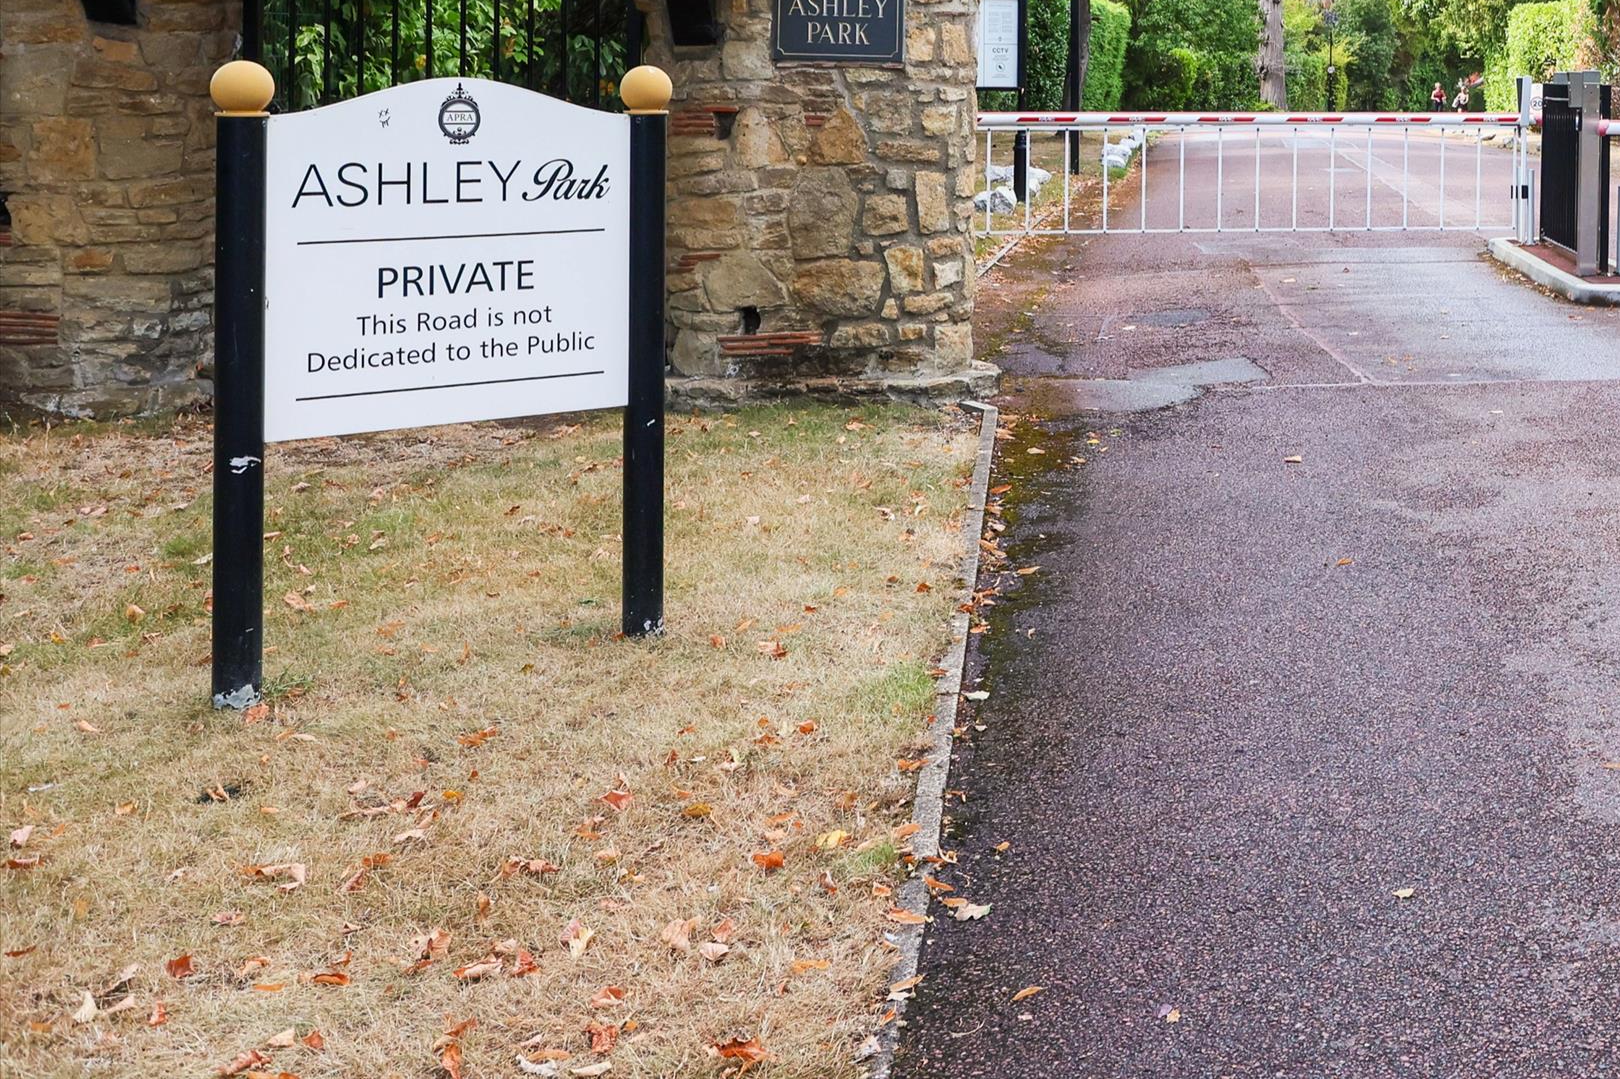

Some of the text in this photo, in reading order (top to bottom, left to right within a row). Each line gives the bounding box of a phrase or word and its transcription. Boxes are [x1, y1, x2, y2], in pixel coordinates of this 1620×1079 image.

[806, 21, 870, 46] PARK
[446, 113, 474, 122] APRA
[291, 158, 611, 209] ASHLEY Park
[377, 259, 535, 299] PRIVATE
[357, 305, 552, 337] This Road is not
[307, 331, 596, 374] Dedicated to the Public
